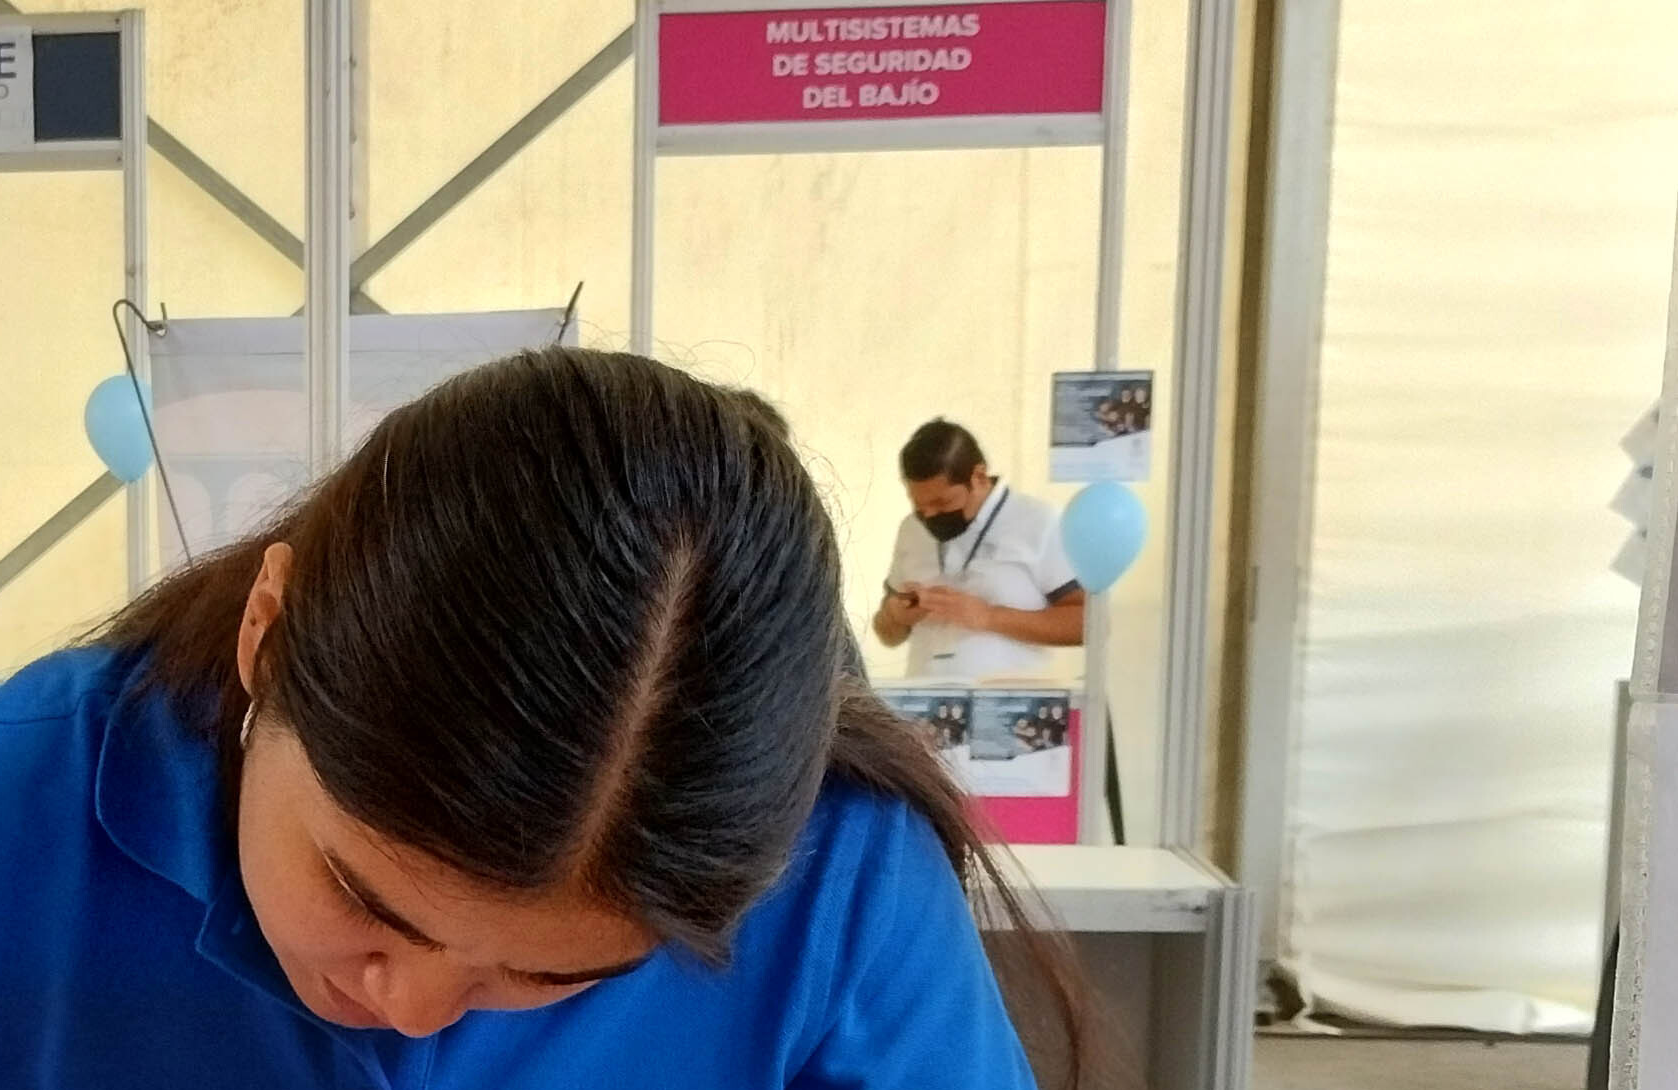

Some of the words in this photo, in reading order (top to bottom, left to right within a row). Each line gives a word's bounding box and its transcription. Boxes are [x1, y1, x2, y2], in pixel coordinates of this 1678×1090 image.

[766, 14, 981, 43] MULTISISTEMAS
[773, 53, 809, 76] DE
[815, 48, 971, 75] SEGURIDAD
[803, 86, 852, 108] DEL
[859, 80, 939, 106] BAJÍO
